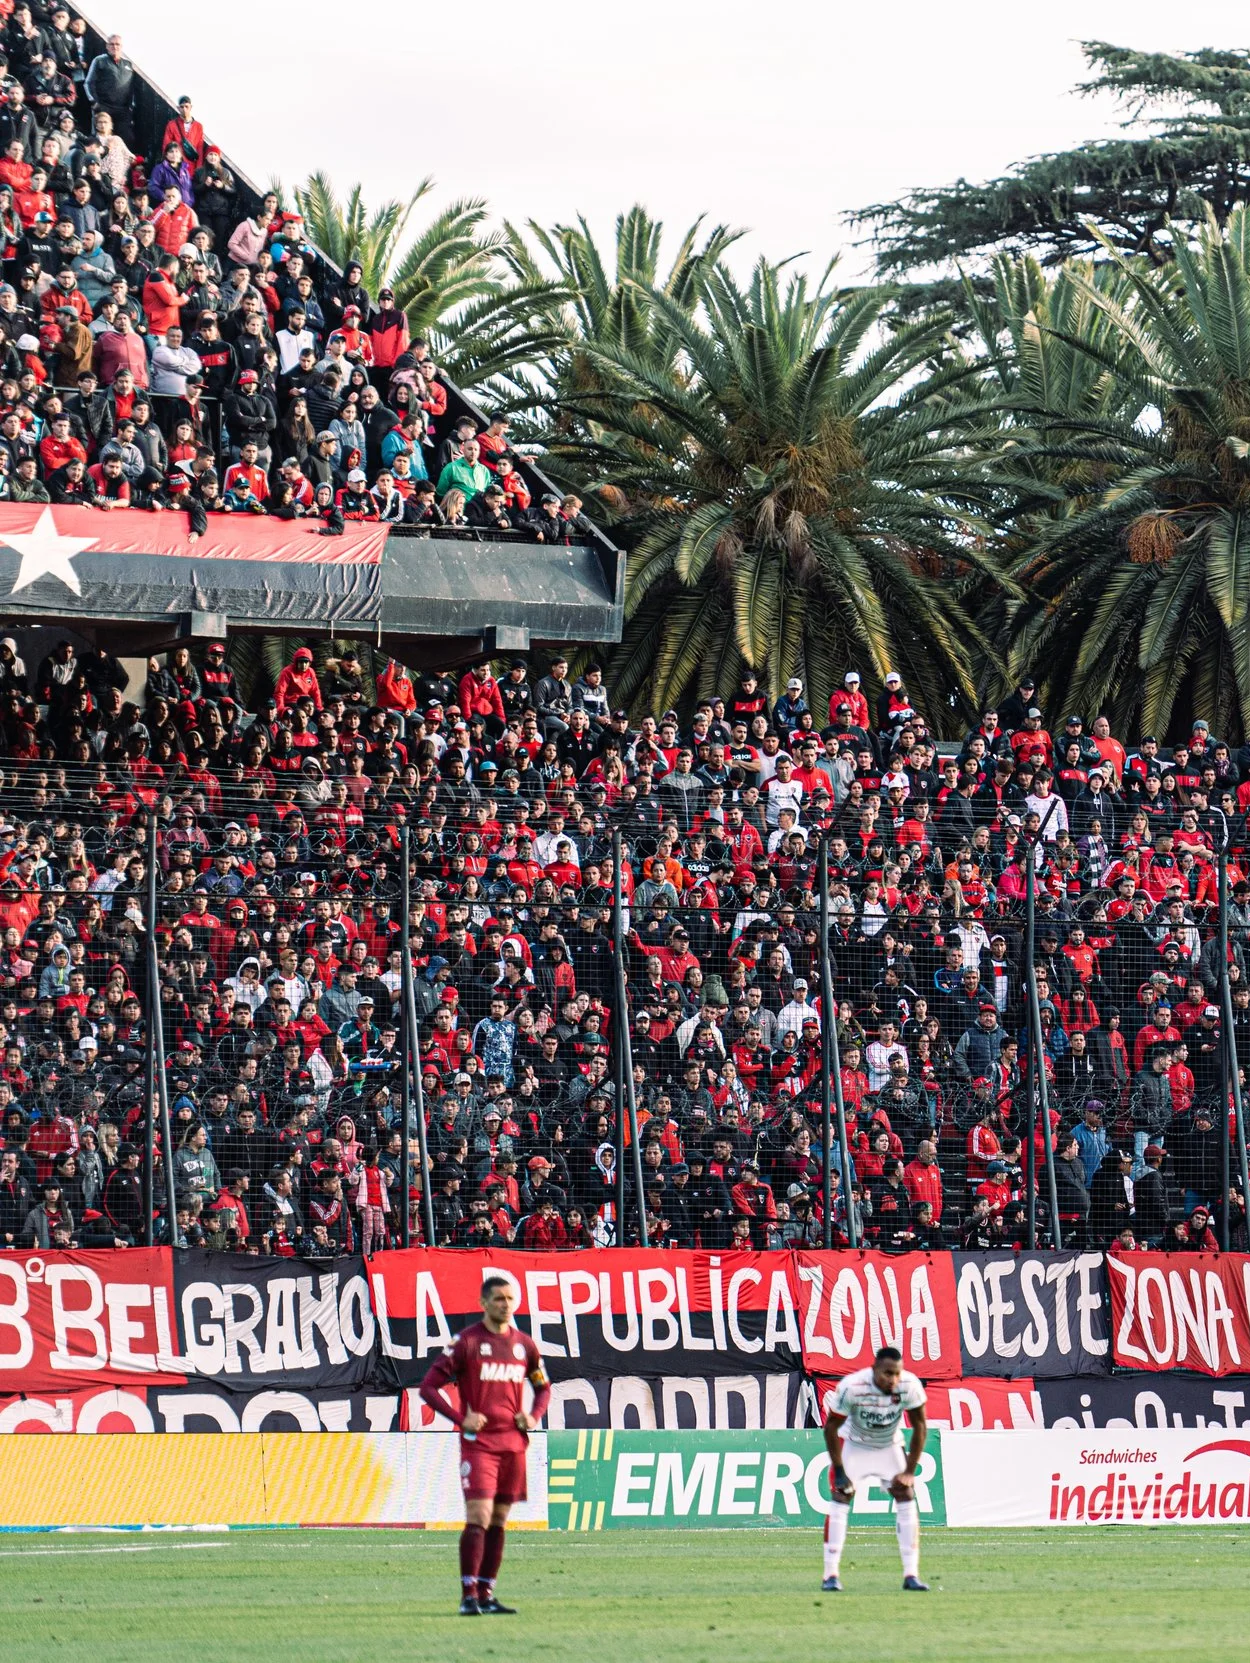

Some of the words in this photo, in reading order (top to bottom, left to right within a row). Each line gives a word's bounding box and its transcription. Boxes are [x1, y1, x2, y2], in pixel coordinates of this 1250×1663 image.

[45, 1264, 376, 1375] BELGRANO
[372, 1271, 454, 1360] LA
[800, 1261, 941, 1361] ZONA
[961, 1252, 1108, 1360] OESTE
[1108, 1255, 1241, 1371] ZONA
[1079, 1447, 1157, 1465] Sándwiches
